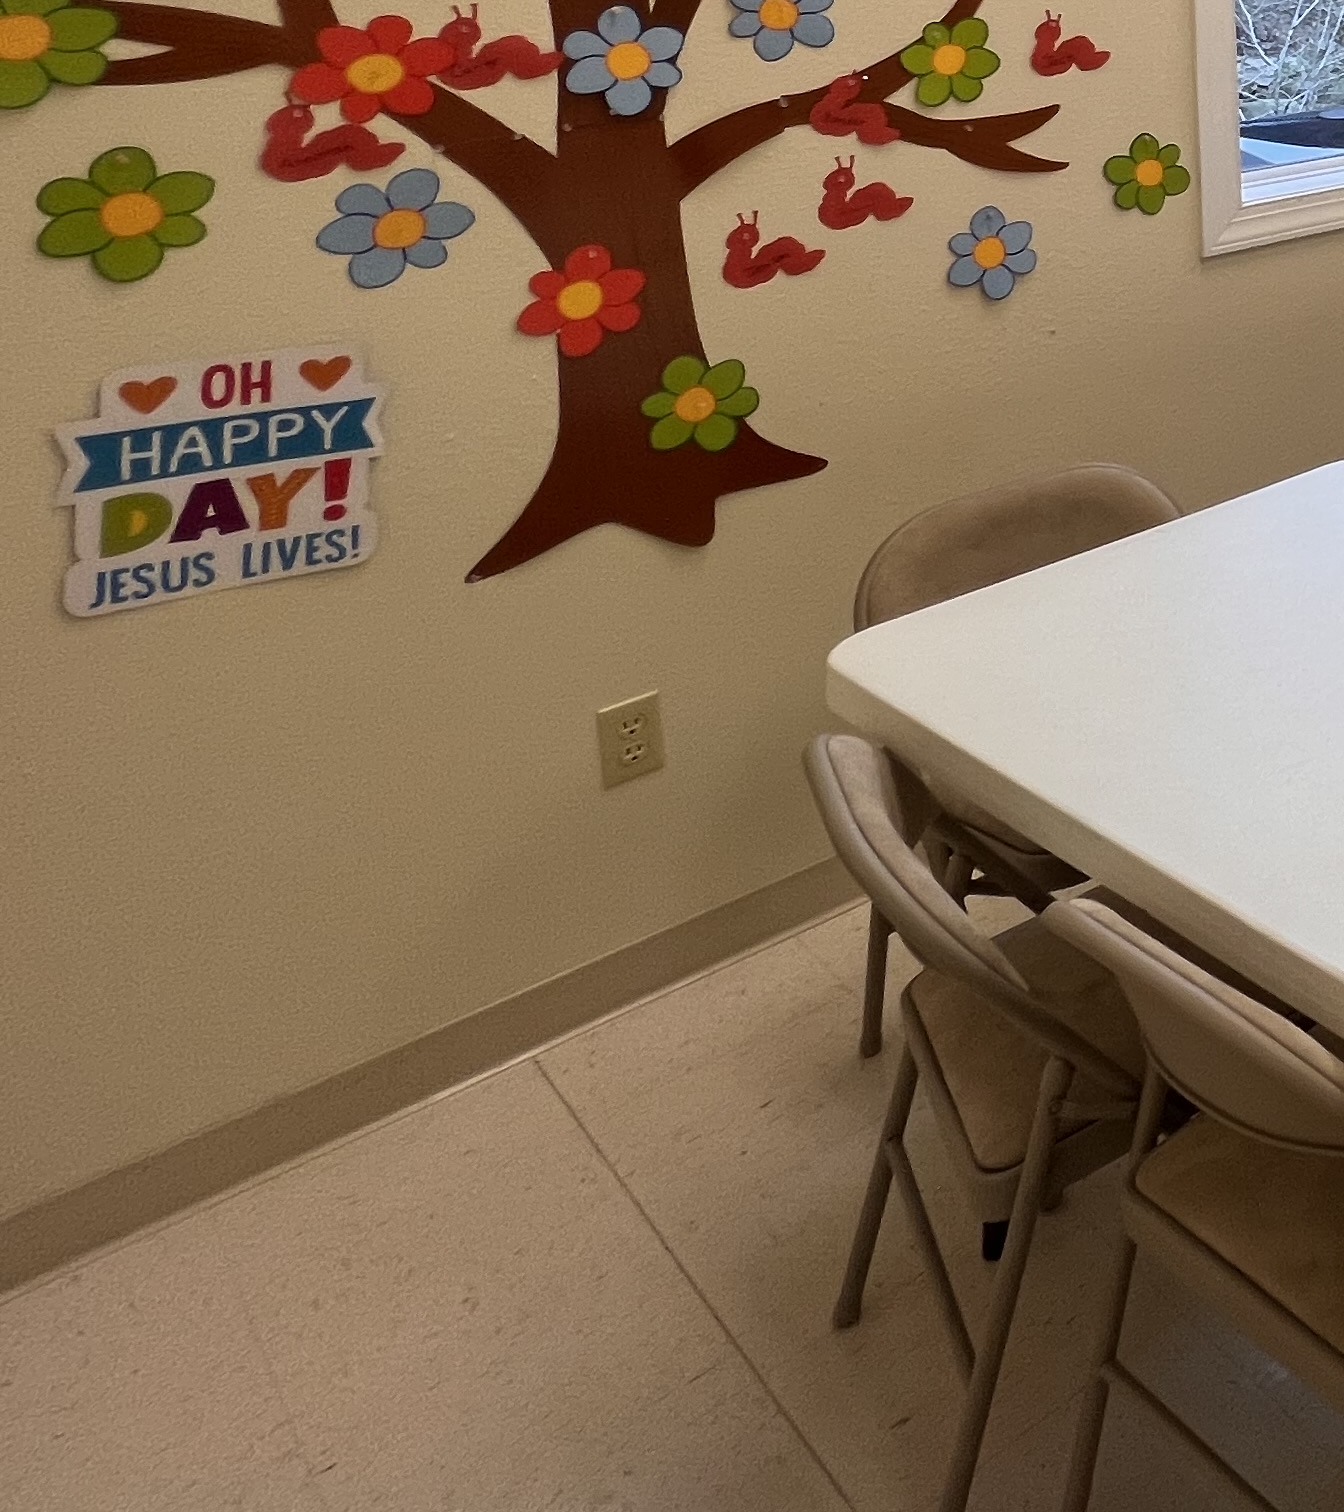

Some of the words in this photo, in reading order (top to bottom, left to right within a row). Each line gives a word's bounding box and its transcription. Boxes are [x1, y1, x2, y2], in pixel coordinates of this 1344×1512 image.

[201, 359, 272, 409] OH
[120, 405, 349, 480] HAPPY
[98, 457, 352, 559] DAY!
[89, 552, 216, 610] JESUS
[241, 524, 361, 579] LIVES!
